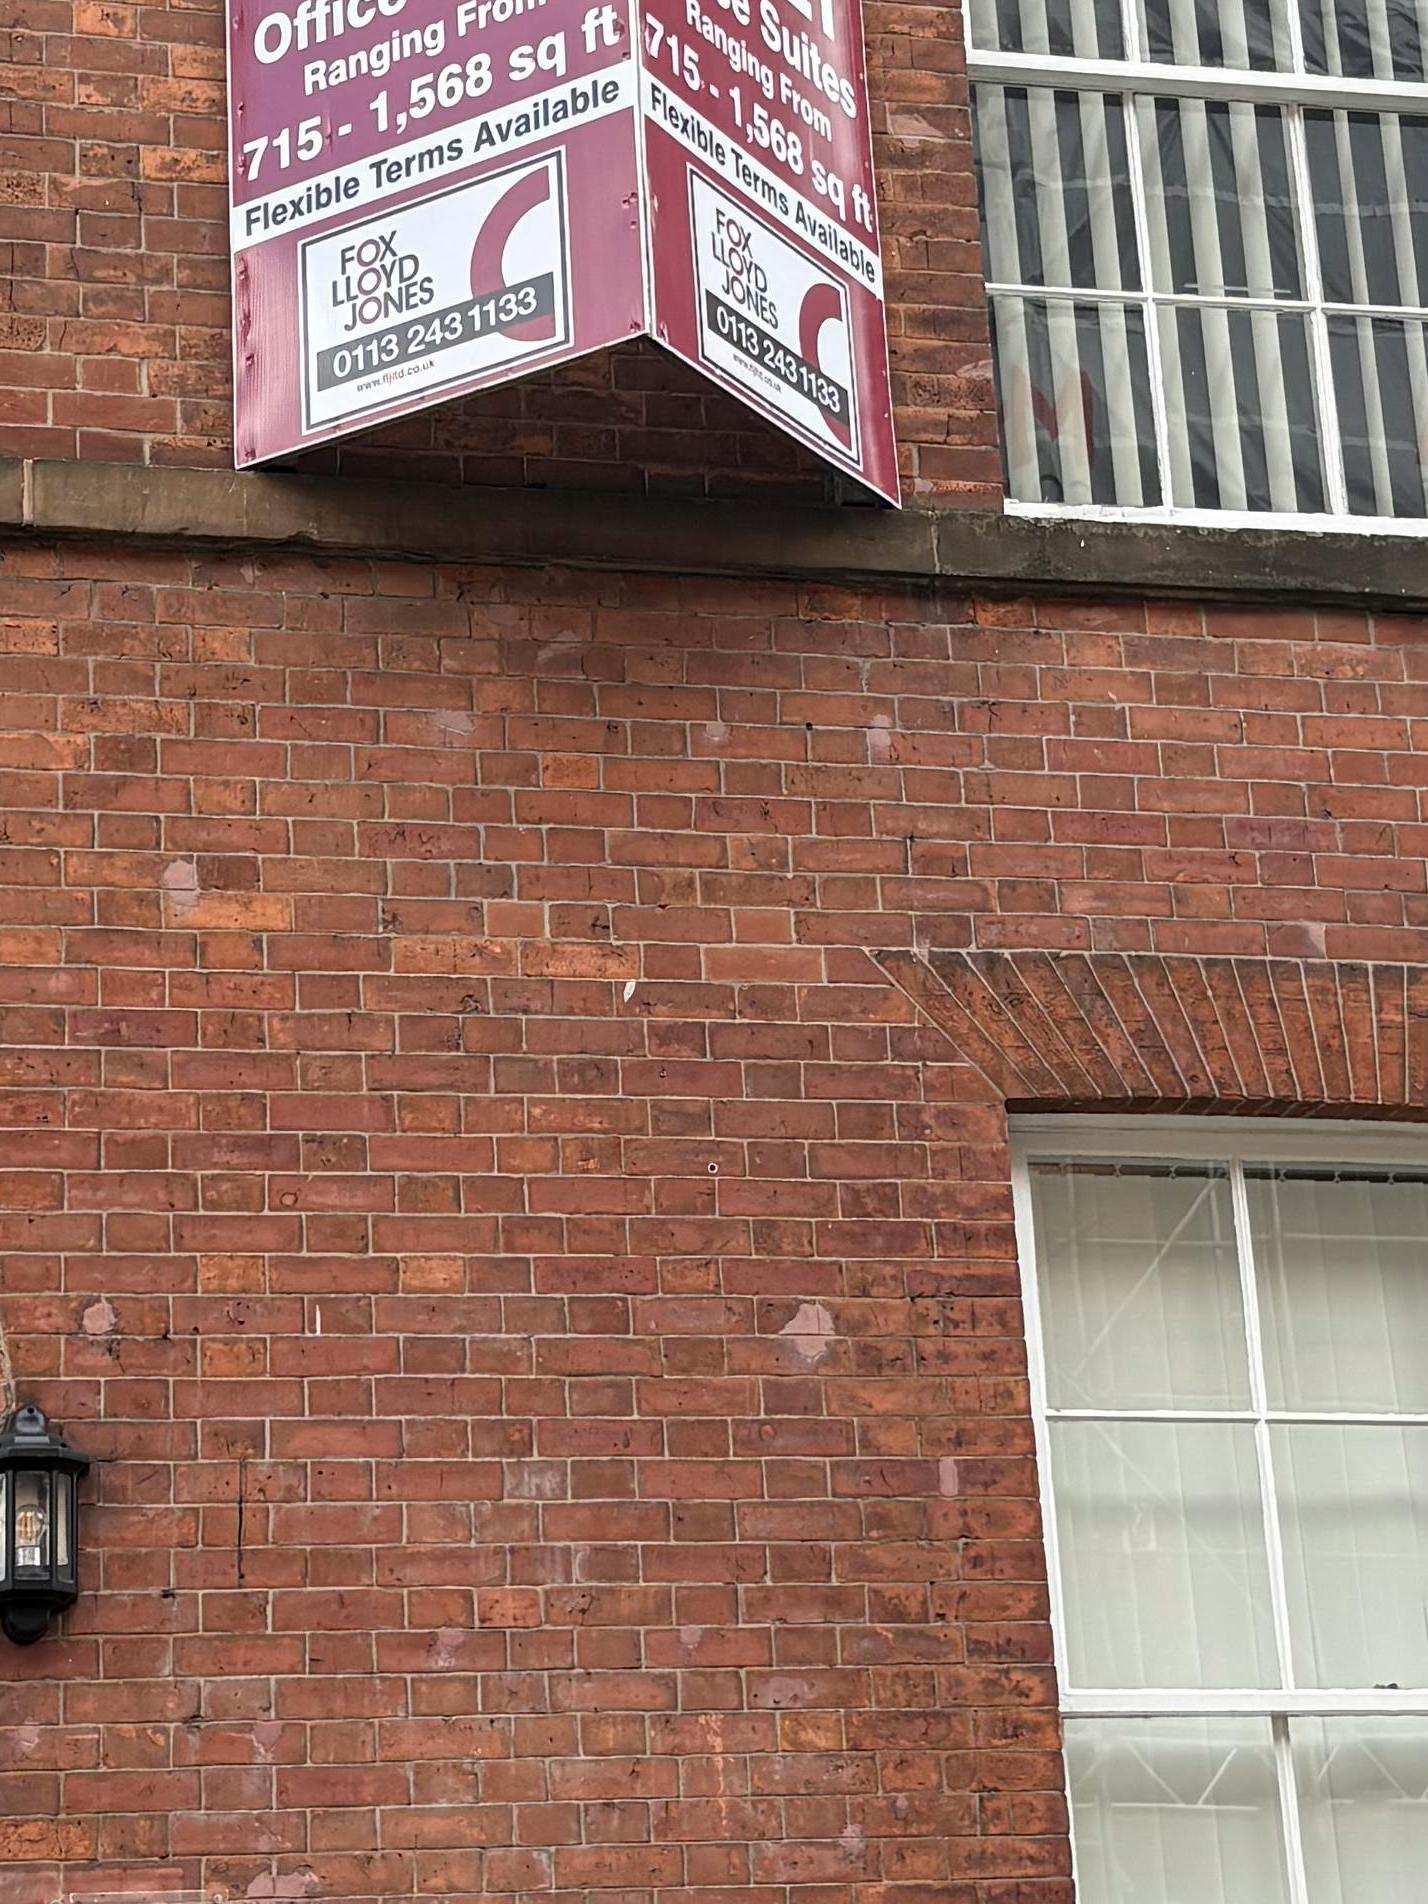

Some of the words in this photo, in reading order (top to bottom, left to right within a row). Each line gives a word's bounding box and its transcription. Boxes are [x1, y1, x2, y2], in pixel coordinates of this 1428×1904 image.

[242, 116, 324, 181] 715
[369, 53, 493, 134] 1,568
[508, 31, 566, 81] sq
[581, 4, 620, 54] ft
[303, 19, 445, 96] Ranging
[645, 12, 701, 92] 715
[729, 86, 803, 175] 1,568
[811, 159, 846, 221] sq
[852, 184, 873, 233] ft
[779, 73, 832, 142] From
[245, 176, 360, 236] Flexible
[369, 138, 464, 189] Terms
[474, 79, 620, 153] Available
[650, 82, 725, 166] Flexible
[731, 147, 789, 216] Terms
[795, 200, 875, 284] Available
[340, 230, 398, 275] FOX
[711, 231, 767, 293] LLOYD
[716, 208, 753, 258] FOX
[332, 254, 419, 307] LLOYD
[343, 276, 435, 332] JONES
[722, 270, 778, 330] JONES
[332, 334, 399, 378] 0113
[407, 312, 463, 354] 243
[467, 287, 537, 331] 1133
[716, 306, 760, 355] 0113
[764, 340, 798, 383] 243
[800, 367, 841, 413] 1133
